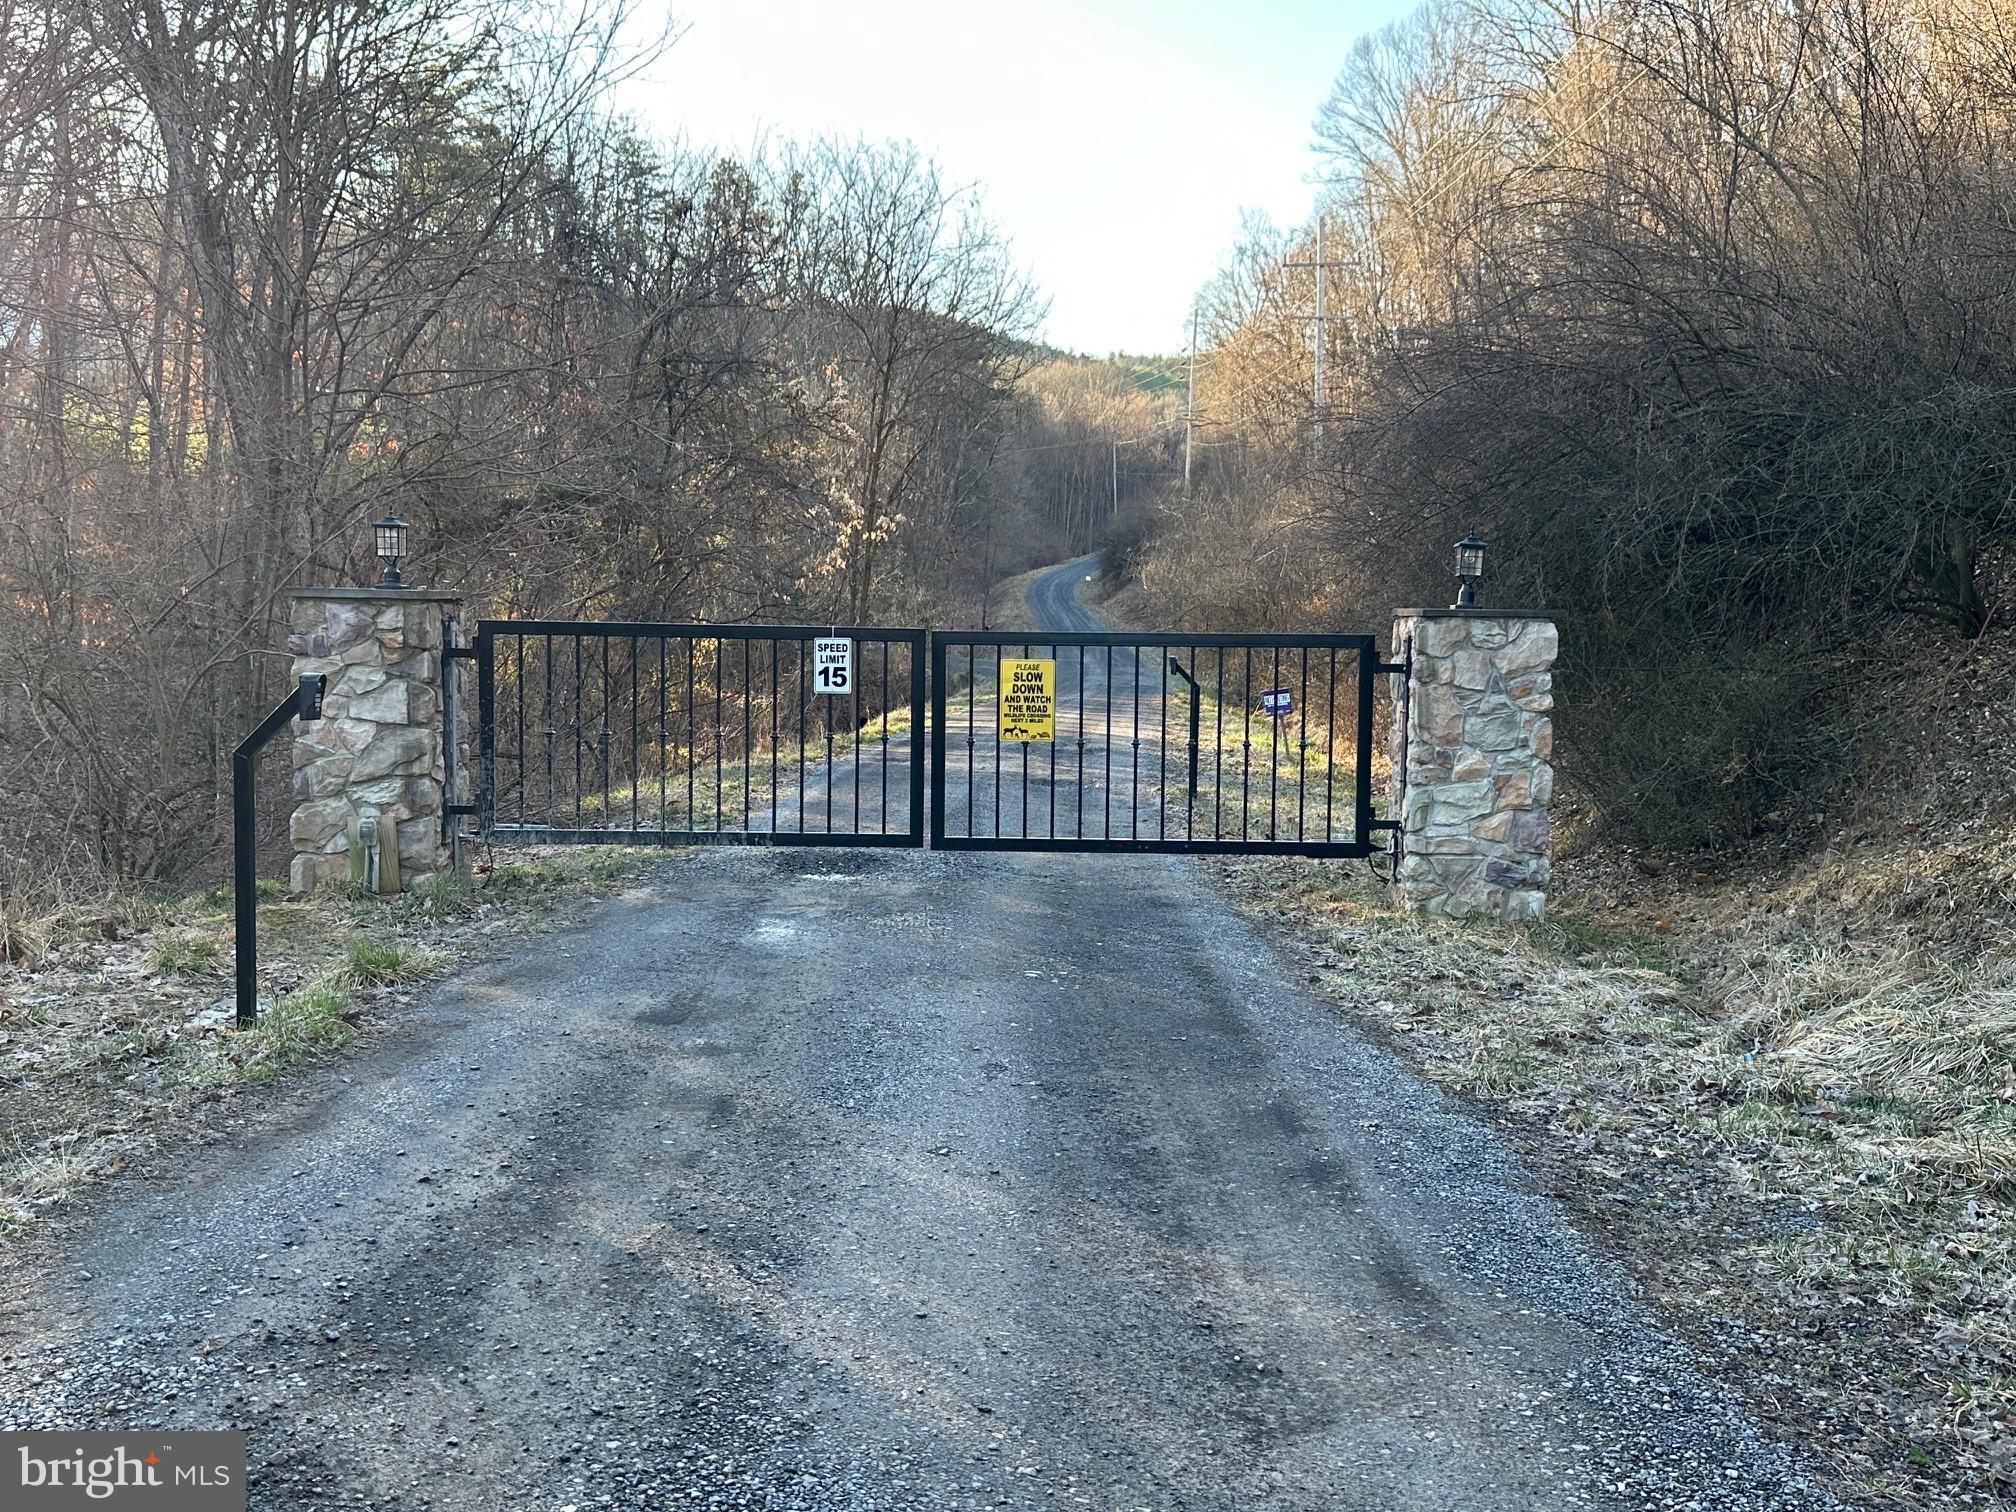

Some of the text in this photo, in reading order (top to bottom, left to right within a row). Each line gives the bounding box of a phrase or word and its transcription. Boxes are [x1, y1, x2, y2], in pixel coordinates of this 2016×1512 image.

[817, 643, 848, 653] SPEED
[820, 655, 846, 664] LIMIT
[1015, 663, 1040, 671] PLEASE
[818, 666, 848, 688] 15
[1013, 672, 1043, 682] SLOW
[1012, 684, 1044, 694] DOWN
[1004, 695, 1051, 704] AND WATCH
[1007, 704, 1048, 713] THE ROAD
